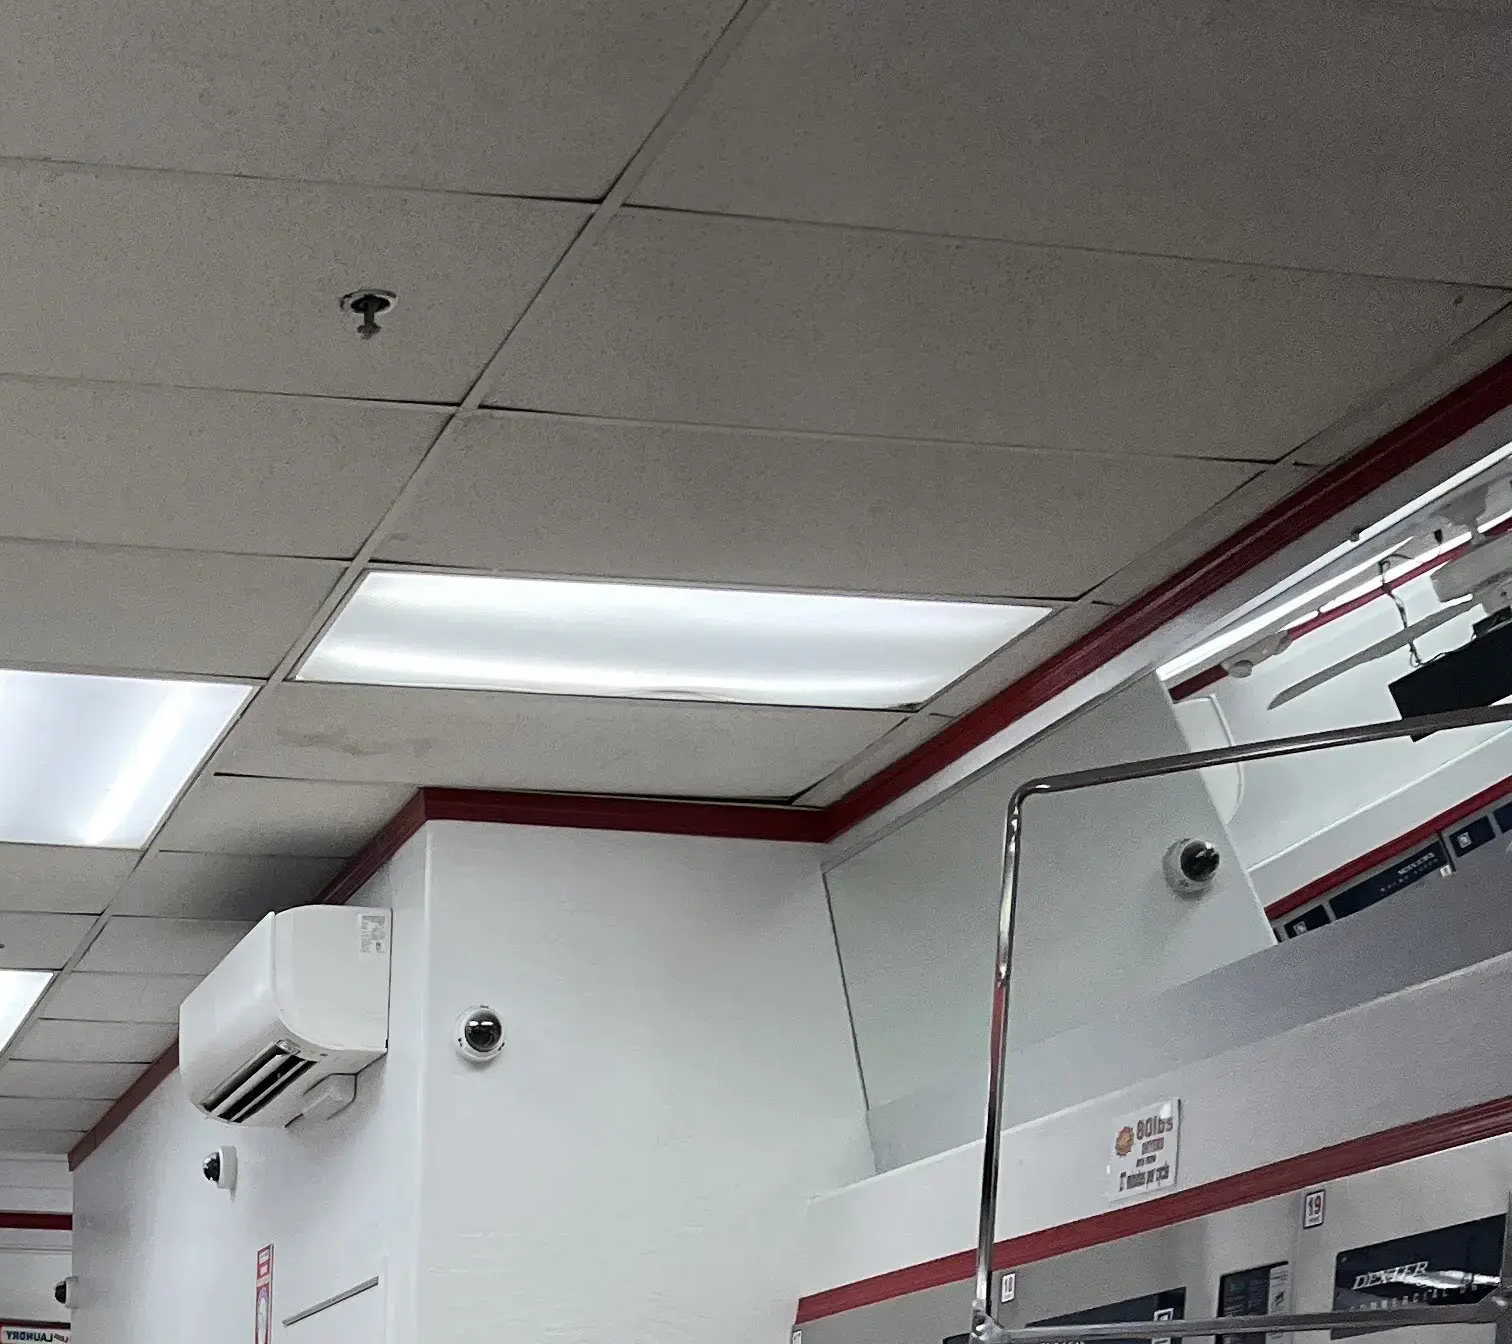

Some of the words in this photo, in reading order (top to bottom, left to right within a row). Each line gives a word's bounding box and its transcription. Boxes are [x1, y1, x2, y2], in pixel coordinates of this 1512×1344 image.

[1137, 1116, 1173, 1140] 80lbs
[1308, 1195, 1322, 1217] 19
[1352, 1261, 1428, 1290] DEXTER
